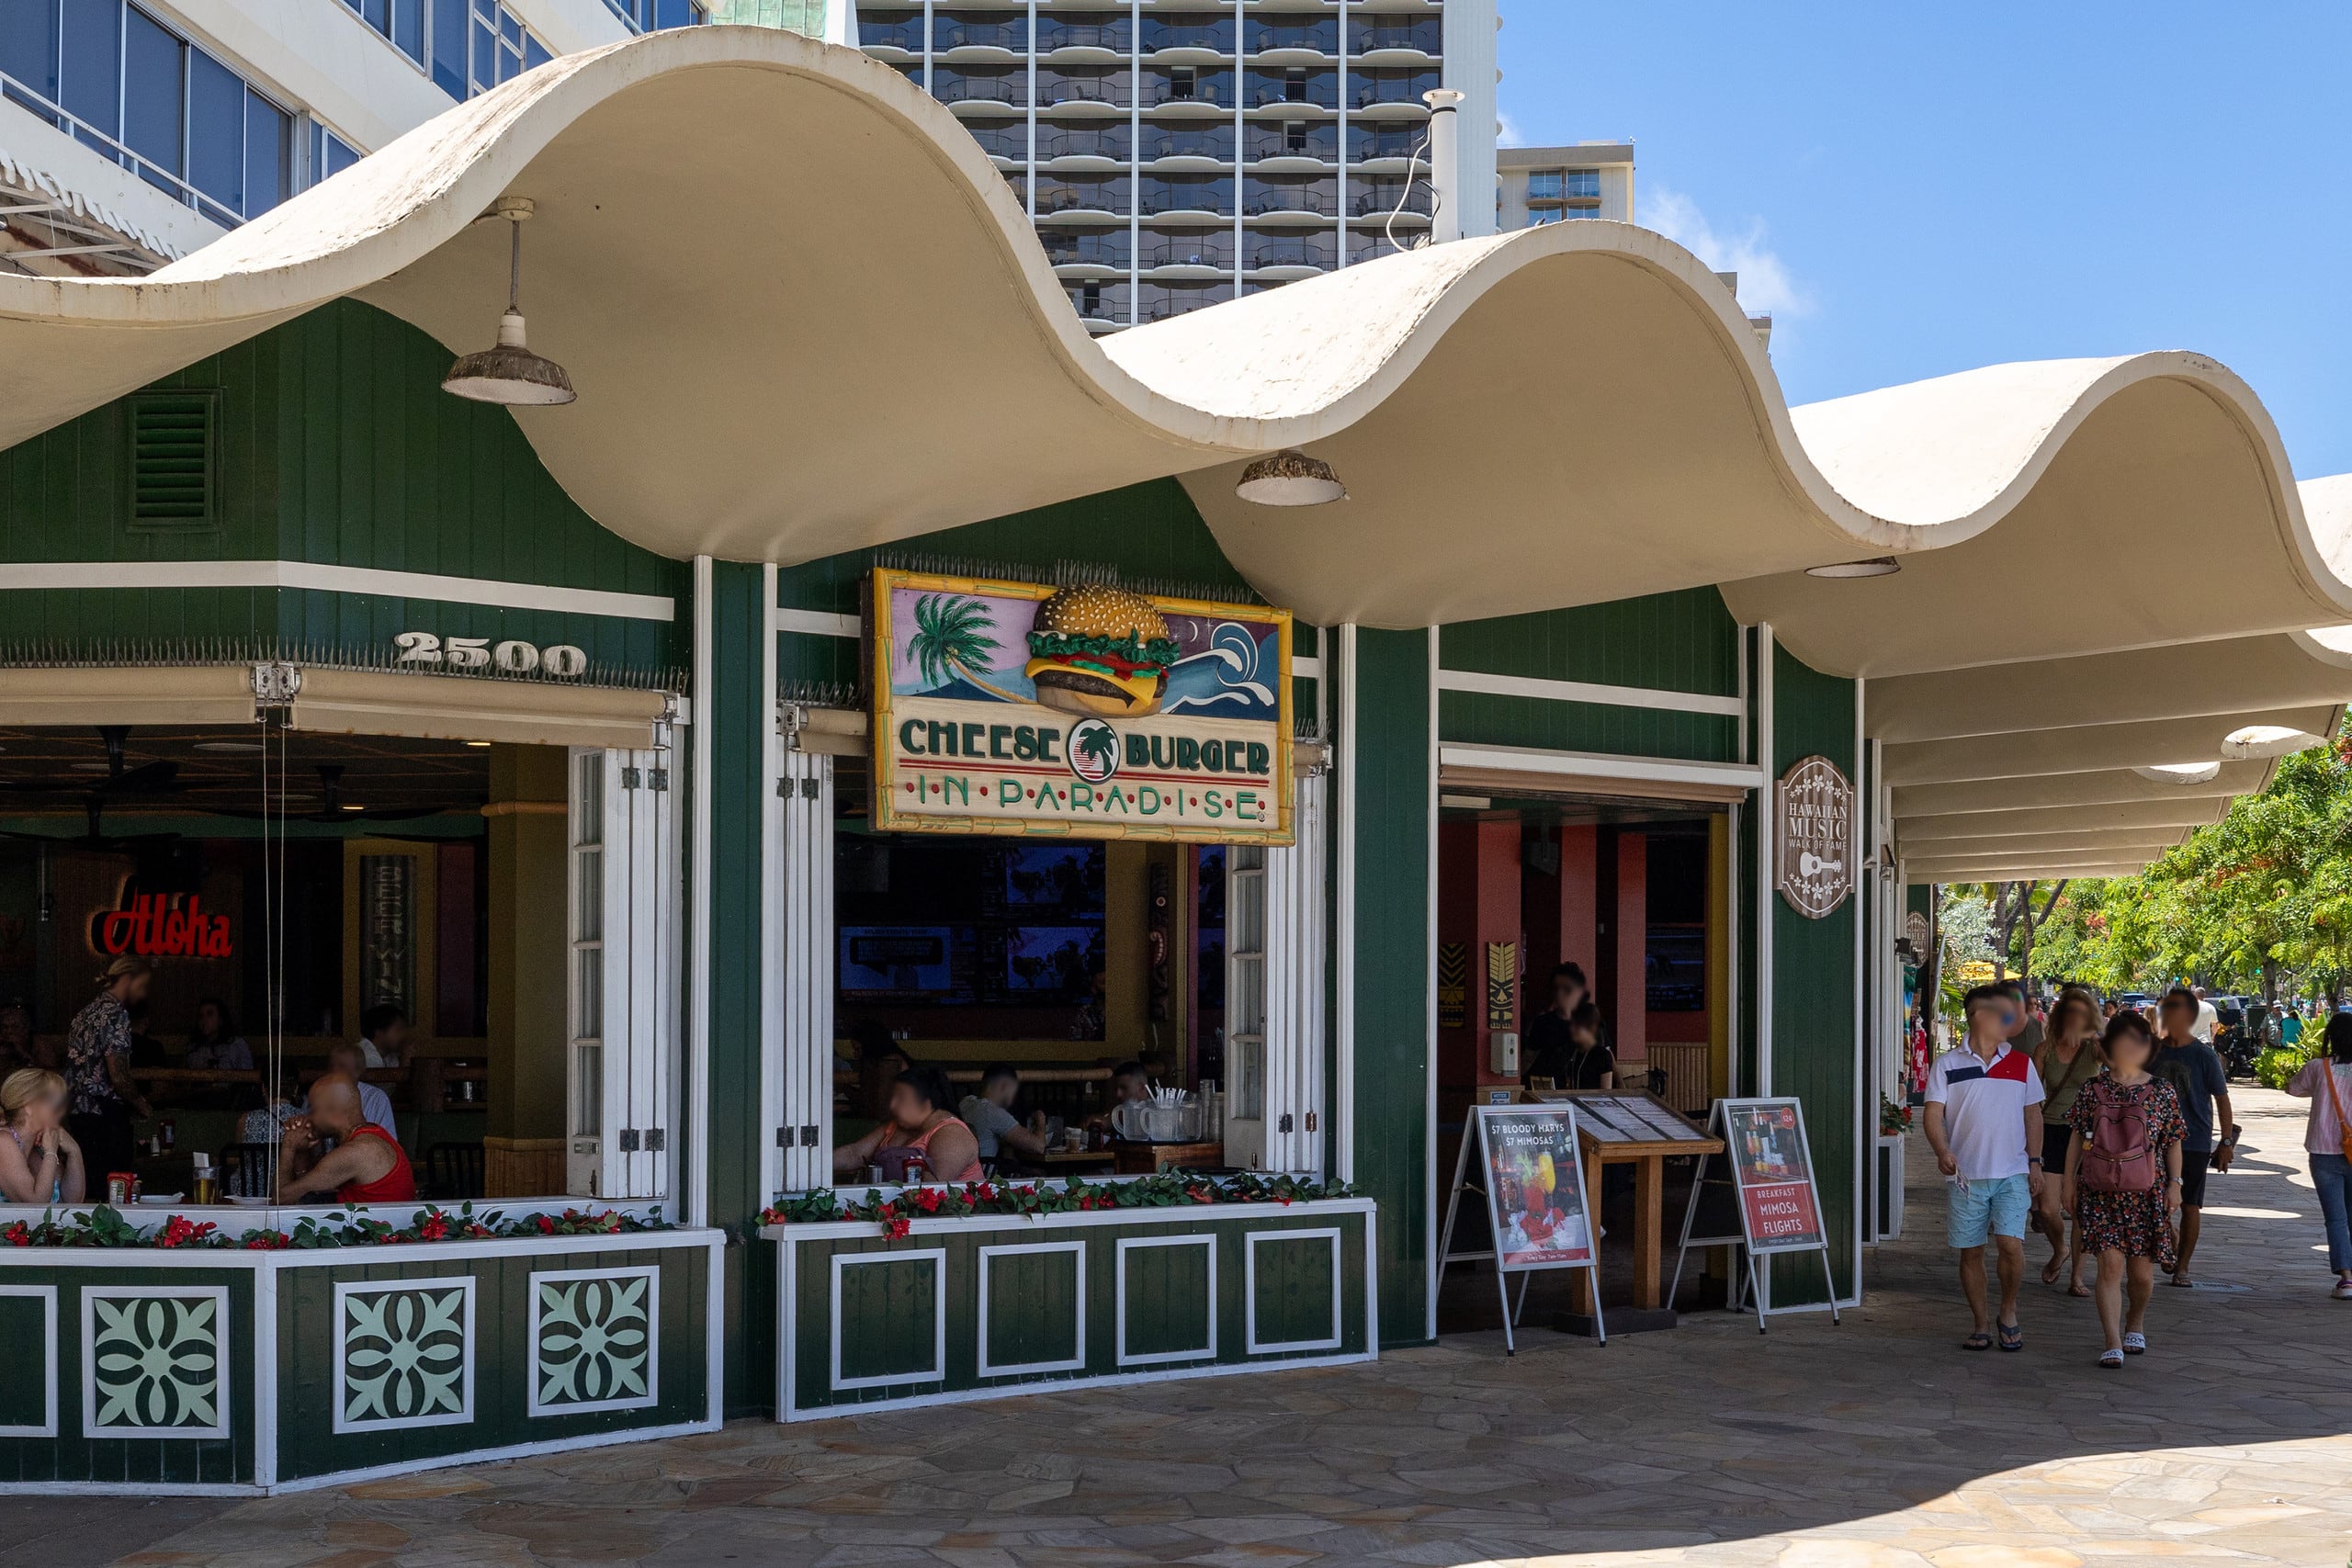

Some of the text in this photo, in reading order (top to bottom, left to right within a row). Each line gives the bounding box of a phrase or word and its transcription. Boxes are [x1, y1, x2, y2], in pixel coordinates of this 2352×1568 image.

[394, 632, 587, 677] 2500
[899, 718, 1270, 774] CHEESE BURGER
[1789, 802, 1848, 818] HAWAIIAN
[1789, 817, 1847, 840] MUSIC
[1789, 839, 1847, 852] WALK OF FAME
[102, 886, 234, 958] Aloha
[1491, 1122, 1565, 1135] $7 BLOODY MARYS
[1506, 1136, 1554, 1146] $7 MIMOSAS
[1757, 1187, 1795, 1199] BREAKFAST
[1760, 1201, 1799, 1216] MIMOSA
[1763, 1218, 1803, 1235] FLIGHTS
